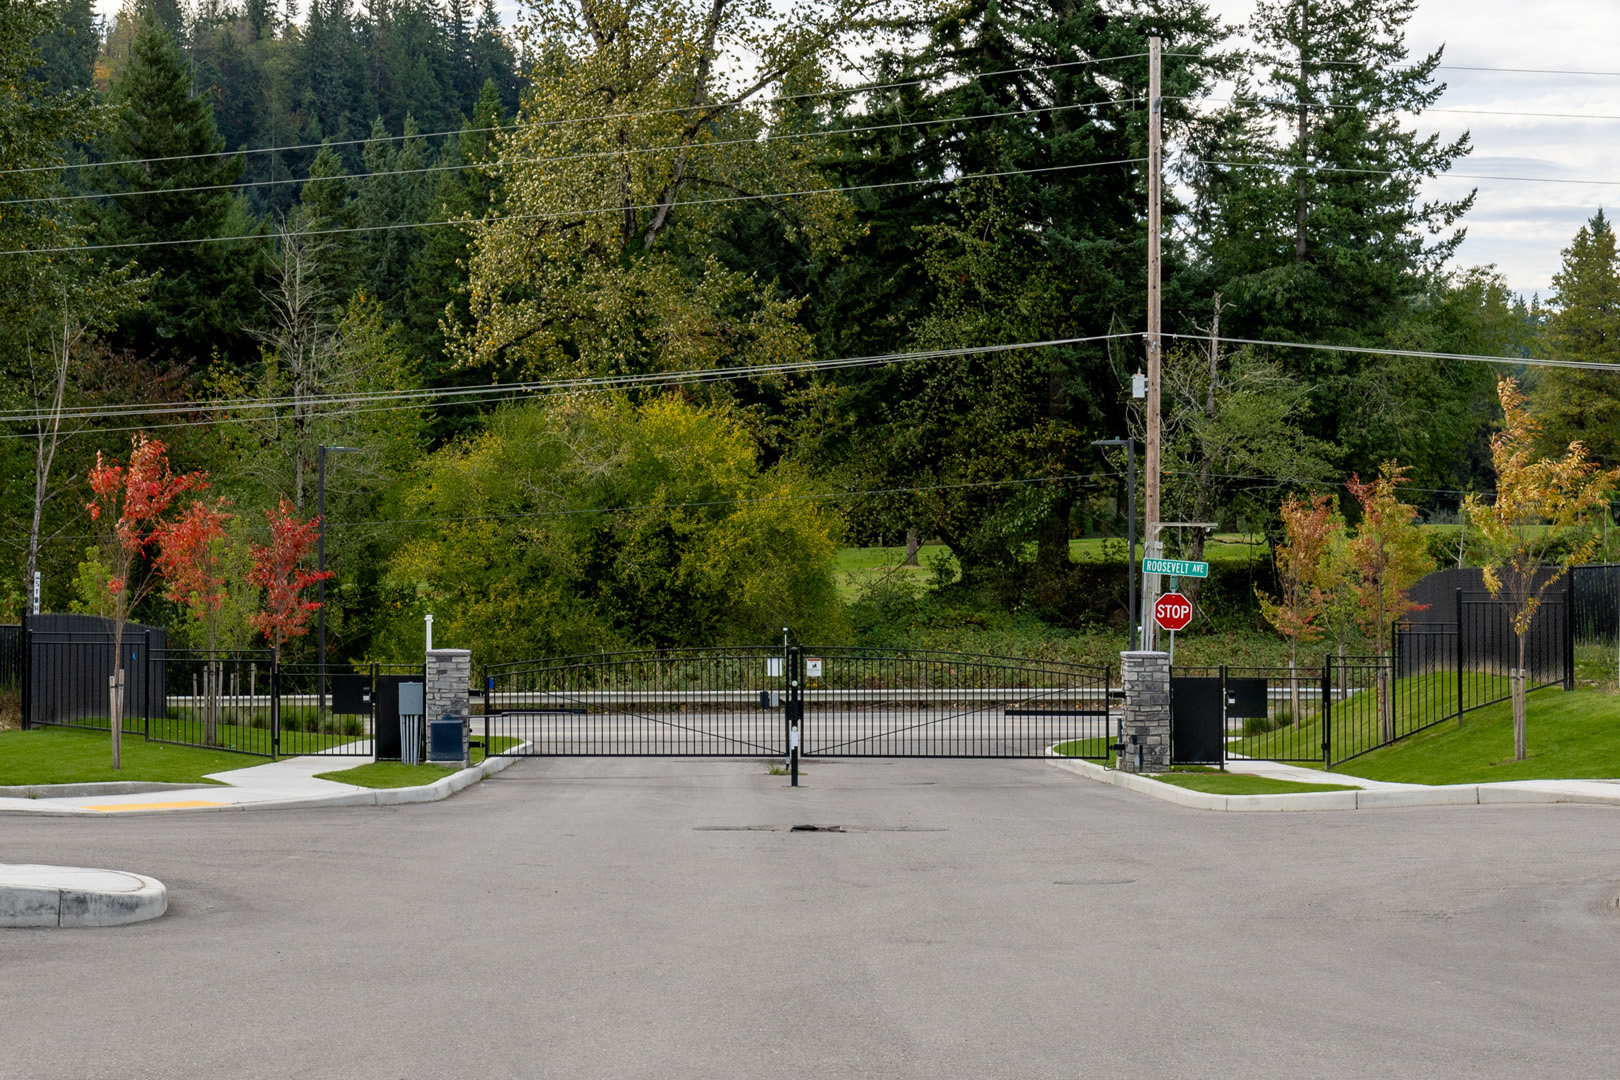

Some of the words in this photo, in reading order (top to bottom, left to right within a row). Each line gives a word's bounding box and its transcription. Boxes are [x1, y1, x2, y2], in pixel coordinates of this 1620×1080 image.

[1146, 561, 1189, 574] ROOSEVELT
[1192, 564, 1204, 573] AVE
[1157, 604, 1189, 619] STOP
